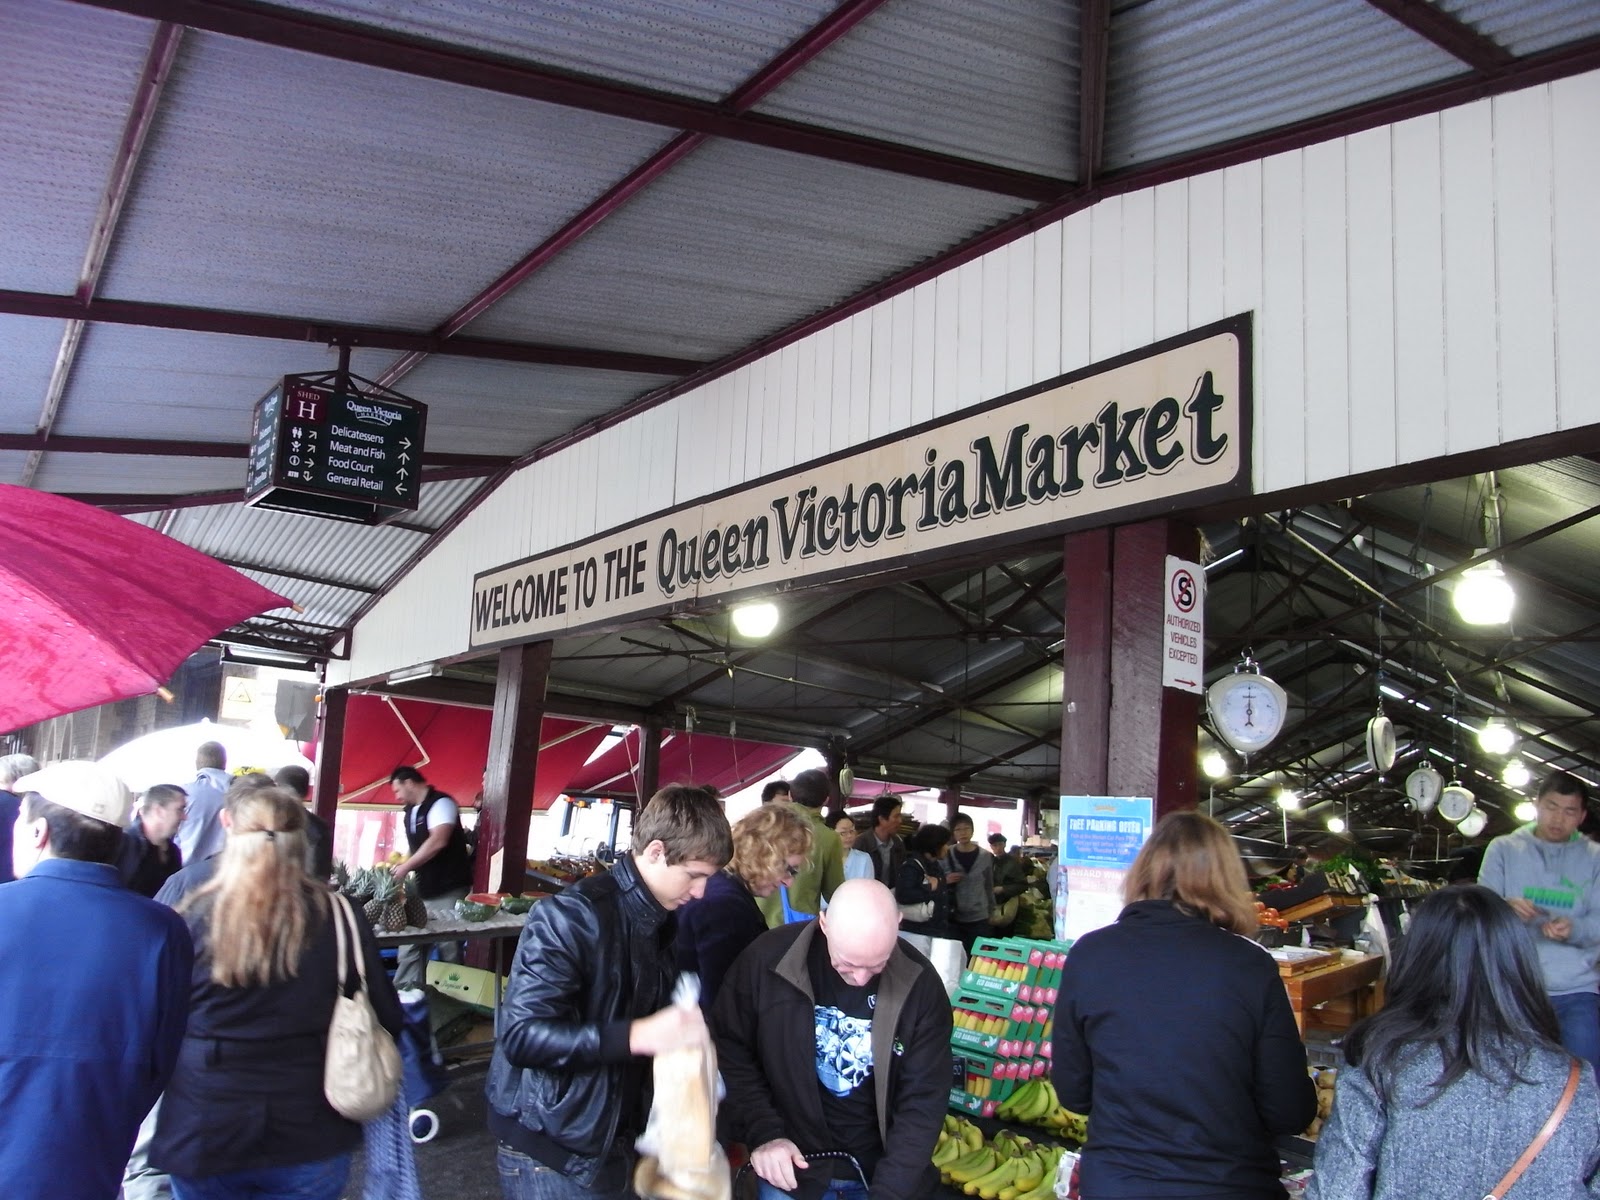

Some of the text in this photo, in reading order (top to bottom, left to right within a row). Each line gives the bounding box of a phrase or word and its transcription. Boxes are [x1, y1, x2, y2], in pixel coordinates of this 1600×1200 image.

[297, 390, 321, 401] SHED
[298, 400, 317, 420] H
[346, 400, 402, 421] Queen Victoria
[331, 425, 384, 444] Delicatessens
[329, 440, 386, 460] Meat and Fish
[328, 456, 374, 474] Food Court
[326, 472, 384, 491] General Retail
[475, 370, 1228, 632] WELCOME TO THE Queen Victoria Market
[1166, 614, 1201, 633] AUTHORIZED
[1170, 631, 1197, 648] VEHICLES
[1169, 647, 1198, 664] EXCEPTED
[1069, 818, 1141, 834] FREE PARKING OFFER
